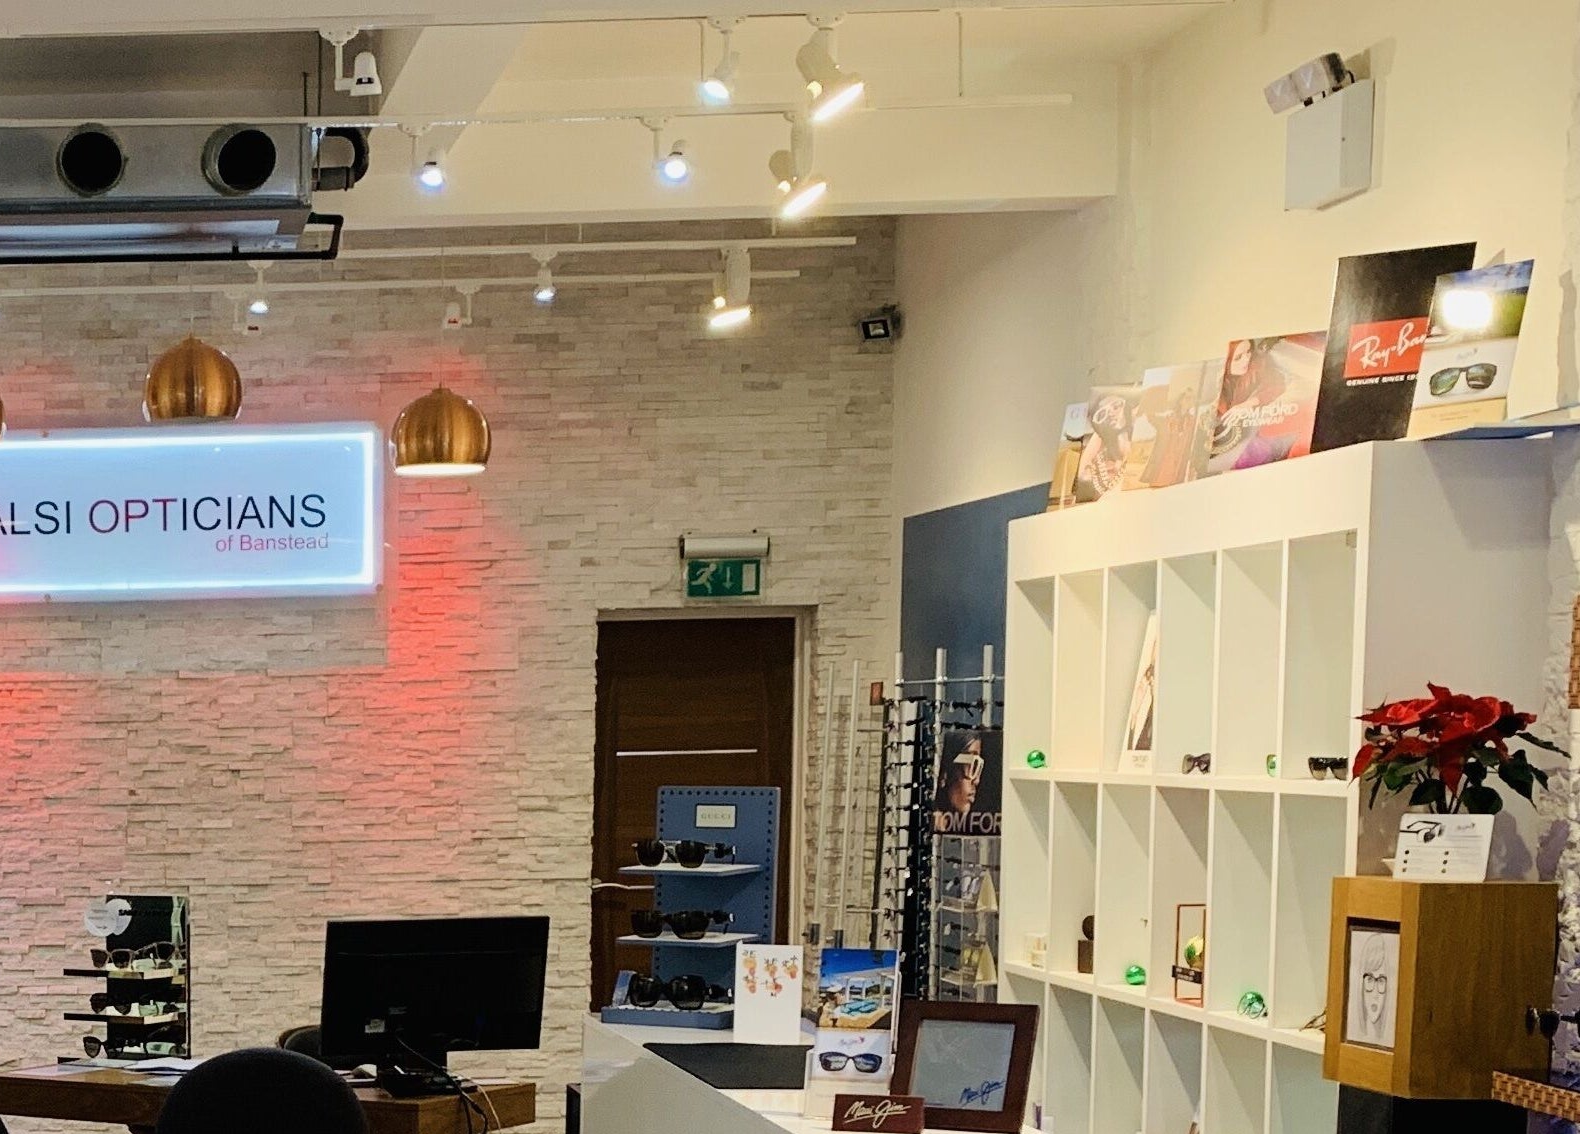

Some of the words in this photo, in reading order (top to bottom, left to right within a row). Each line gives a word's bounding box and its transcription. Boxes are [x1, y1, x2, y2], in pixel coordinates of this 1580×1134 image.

[88, 493, 327, 534] OPTICIANS
[215, 534, 234, 553] of
[239, 533, 330, 552] Banstead
[933, 811, 968, 833] TOM
[844, 1101, 874, 1123] Maui
[873, 1099, 912, 1129] Jim
